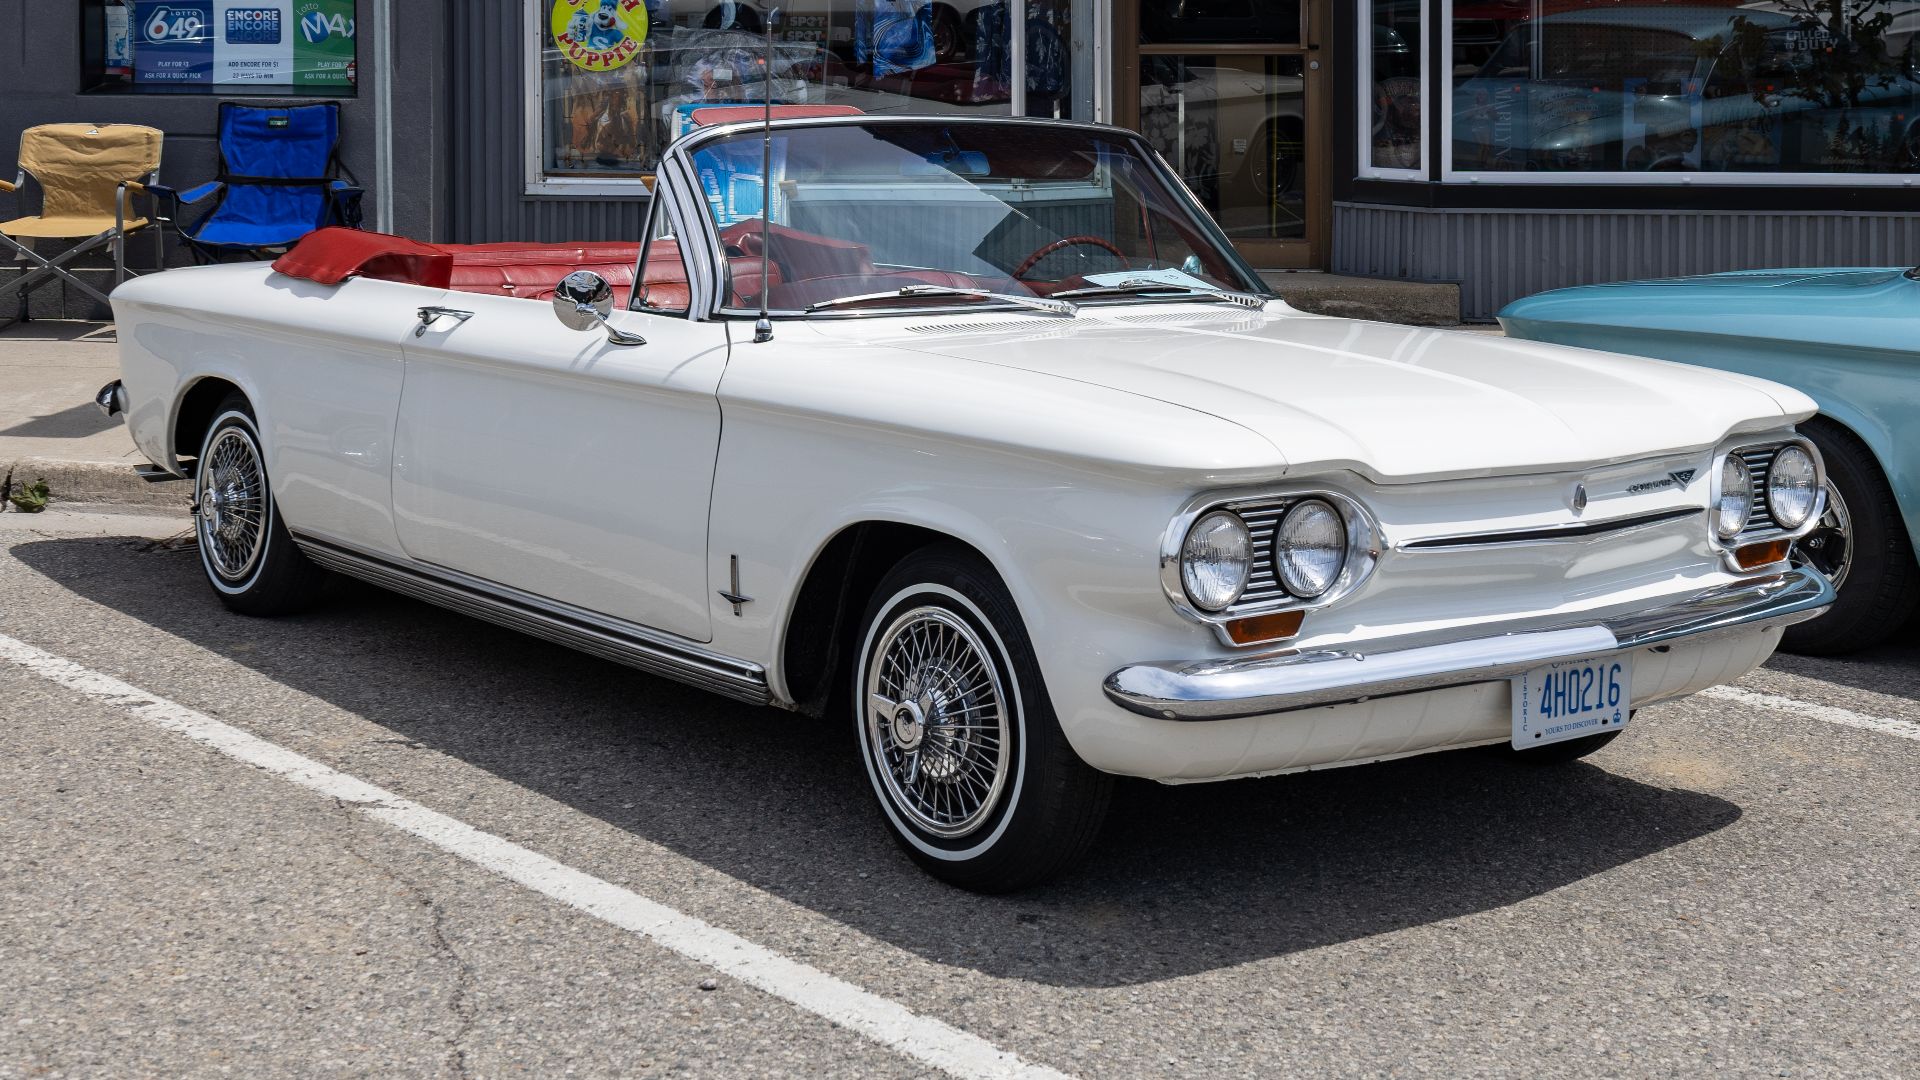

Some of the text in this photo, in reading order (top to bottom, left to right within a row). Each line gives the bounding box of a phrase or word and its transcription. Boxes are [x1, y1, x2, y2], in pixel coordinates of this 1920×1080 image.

[227, 10, 279, 21] ENCORE
[296, 3, 319, 16] Lotto
[227, 21, 279, 31] ENCORE
[227, 31, 279, 41] ENCORE
[557, 33, 639, 67] PUPPIE
[1798, 38, 1839, 50] DUTY
[1540, 663, 1621, 719] 4H0216
[1544, 726, 1563, 735] YOURS
[1572, 718, 1598, 730] DISCOVER
